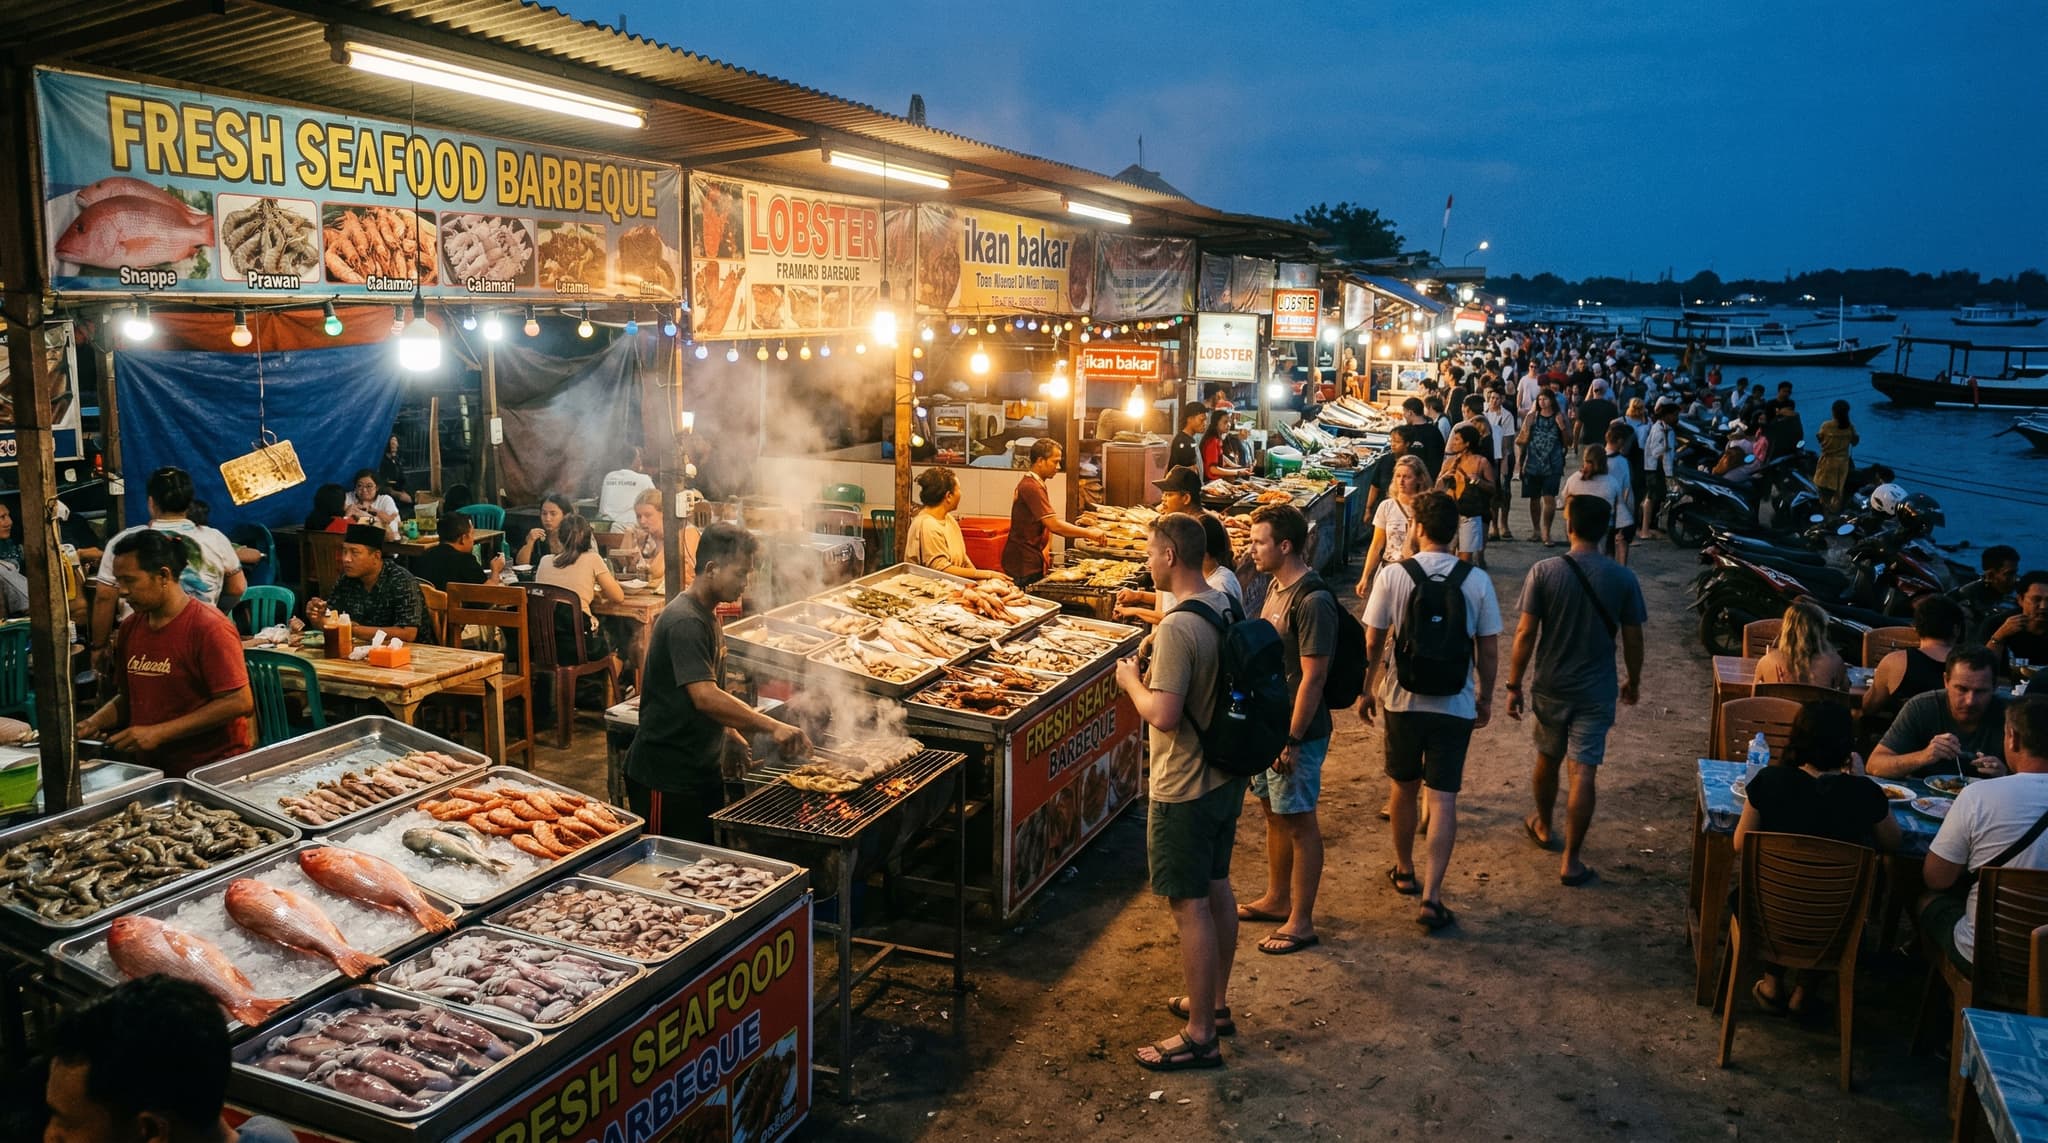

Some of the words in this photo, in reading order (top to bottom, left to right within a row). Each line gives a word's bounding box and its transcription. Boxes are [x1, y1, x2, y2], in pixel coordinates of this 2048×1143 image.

[108, 94, 285, 185] FRESH
[296, 118, 488, 202] SEAFOOD
[496, 149, 658, 224] BARBEQUE
[748, 192, 881, 261] LOBSTER
[964, 217, 1010, 265] ikan
[1017, 224, 1069, 269] bakar
[247, 269, 300, 289] Prawan
[466, 276, 515, 293] Calamari
[821, 266, 860, 281] BAREQUE
[1086, 355, 1113, 369] ikan
[1116, 355, 1155, 371] bakar
[1200, 347, 1253, 361] LOBSTER
[1025, 701, 1073, 763] FRESH
[1048, 707, 1116, 781] BARBEQUE
[631, 929, 796, 1085] SEAFOOD
